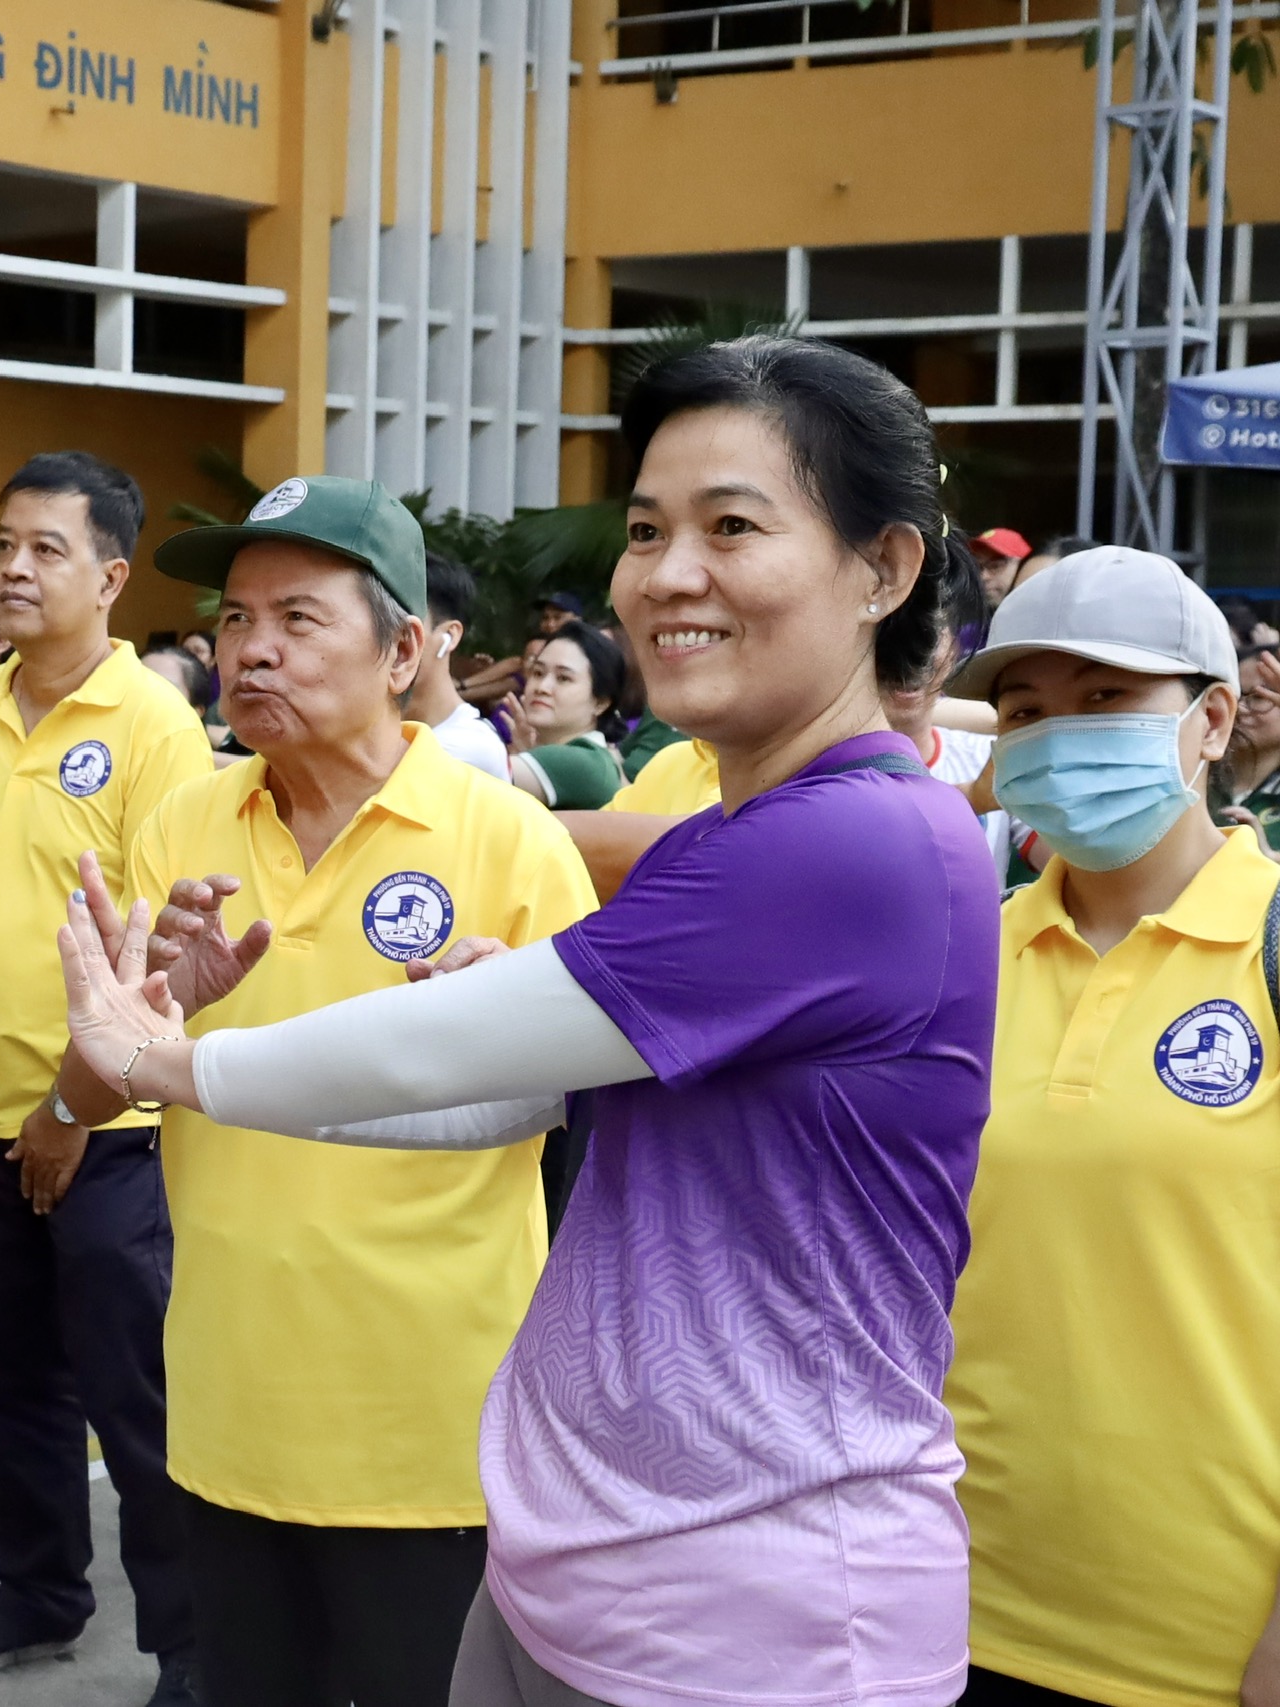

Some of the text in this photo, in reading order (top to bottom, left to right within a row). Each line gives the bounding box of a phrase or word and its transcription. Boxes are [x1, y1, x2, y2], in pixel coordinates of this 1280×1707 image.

[34, 31, 135, 113] ĐỊNH
[163, 40, 259, 129] MÌNH
[1229, 428, 1280, 448] Hot
[367, 927, 385, 951] THÀNH
[383, 948, 399, 959] PHỐ
[424, 937, 442, 955] MINH
[1160, 1067, 1184, 1094] THÀNH
[1183, 1089, 1205, 1102] PHỐ
[1234, 1080, 1252, 1100] MINH
